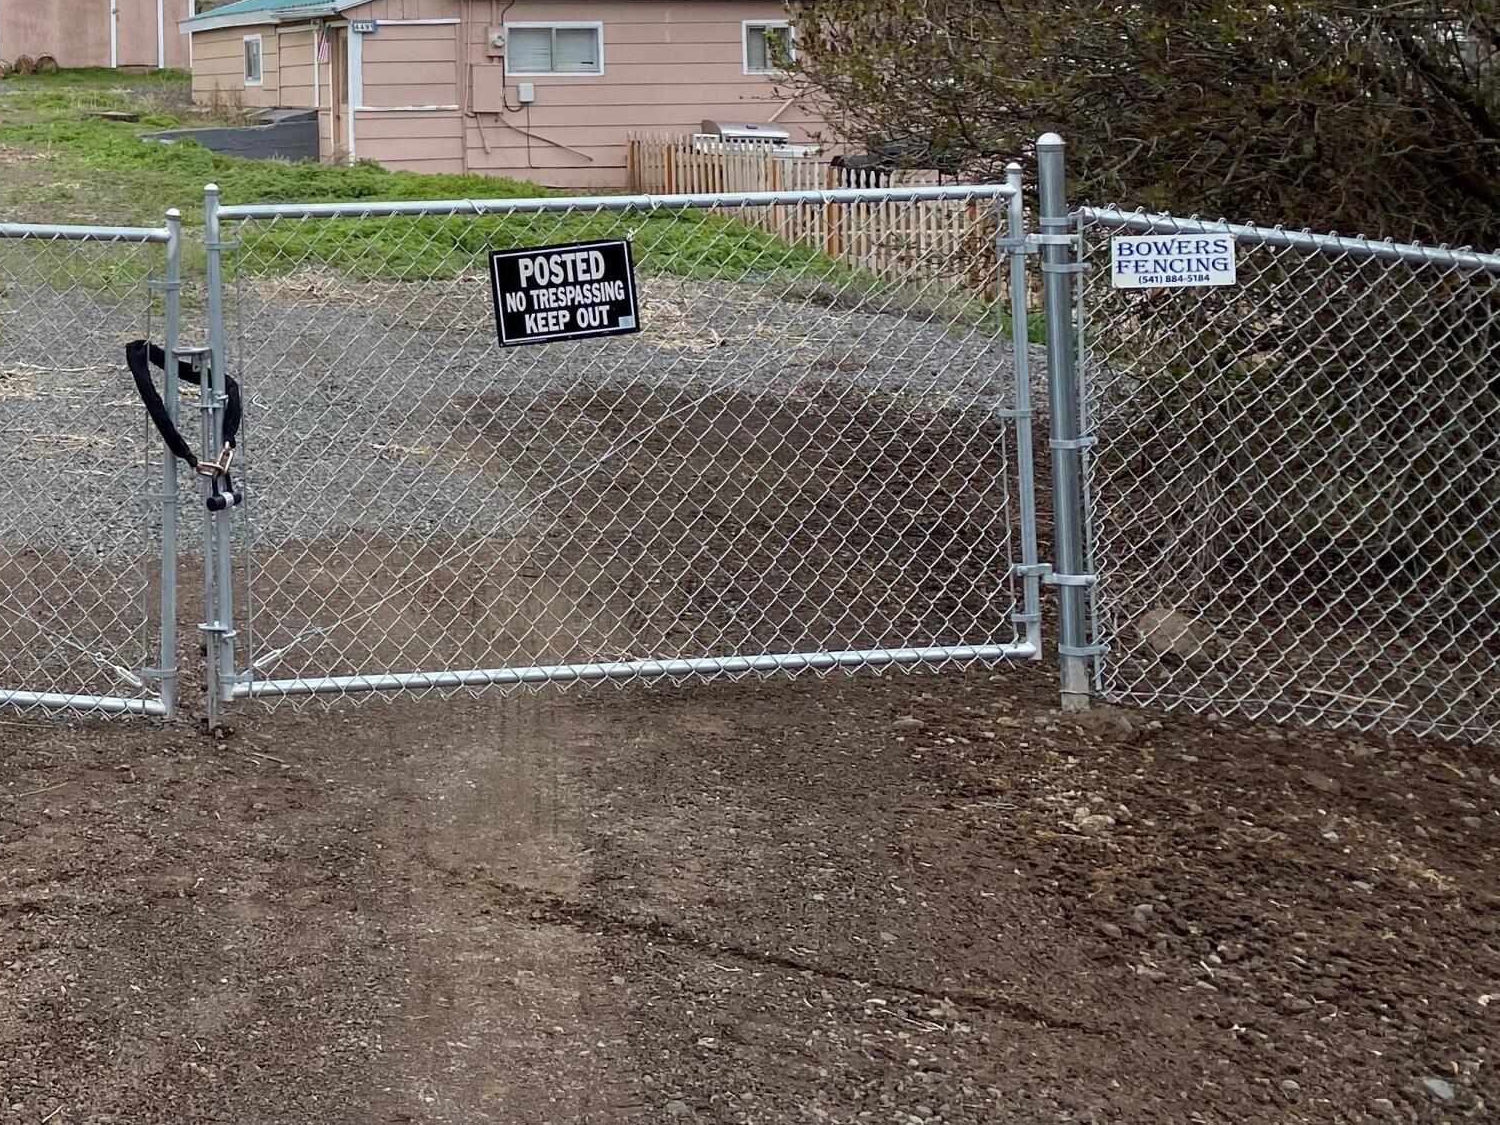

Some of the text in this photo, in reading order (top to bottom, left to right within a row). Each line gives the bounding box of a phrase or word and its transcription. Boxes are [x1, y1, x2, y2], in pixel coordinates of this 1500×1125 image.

[1117, 239, 1228, 257] BOWERS
[518, 250, 605, 288] POSTED
[1116, 257, 1229, 274] FENCING
[1138, 274, 1210, 284] (541) 884-5184
[505, 280, 625, 313] NO TRESPASSING
[524, 305, 610, 334] KEEP OUT
